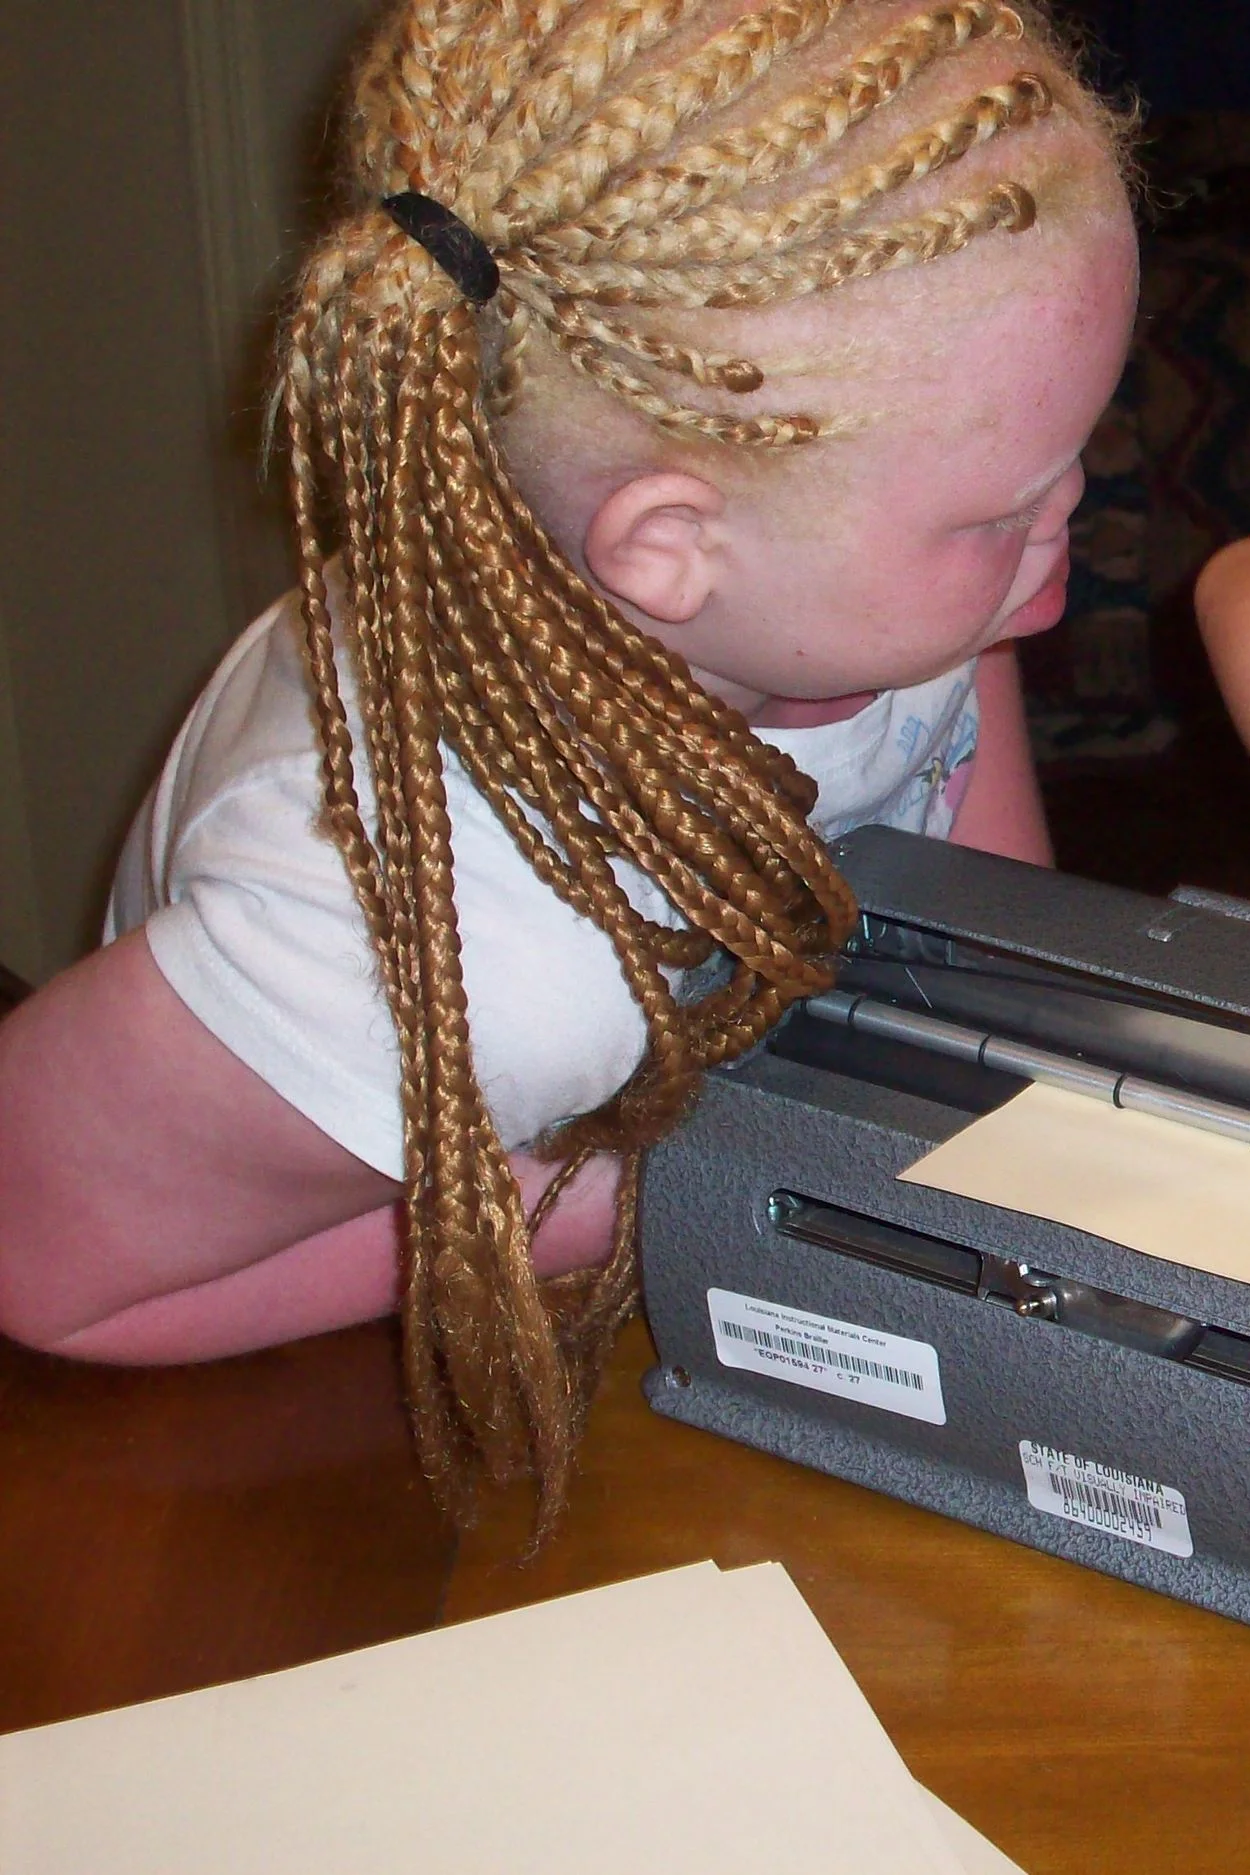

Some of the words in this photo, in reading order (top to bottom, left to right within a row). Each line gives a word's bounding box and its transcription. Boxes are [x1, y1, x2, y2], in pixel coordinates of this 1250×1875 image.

[744, 1303, 780, 1318] Louisiana
[781, 1312, 826, 1331] Instructional
[827, 1325, 860, 1341] Materials
[861, 1335, 887, 1347] Center
[775, 1323, 802, 1338] Perkins
[848, 1374, 861, 1385] 27
[1030, 1441, 1070, 1466] STATE
[1074, 1455, 1090, 1471] OF
[1095, 1462, 1165, 1497] LOUISIANA
[1073, 1468, 1126, 1497] VISUALLY
[1133, 1487, 1187, 1516] IMPAIRED
